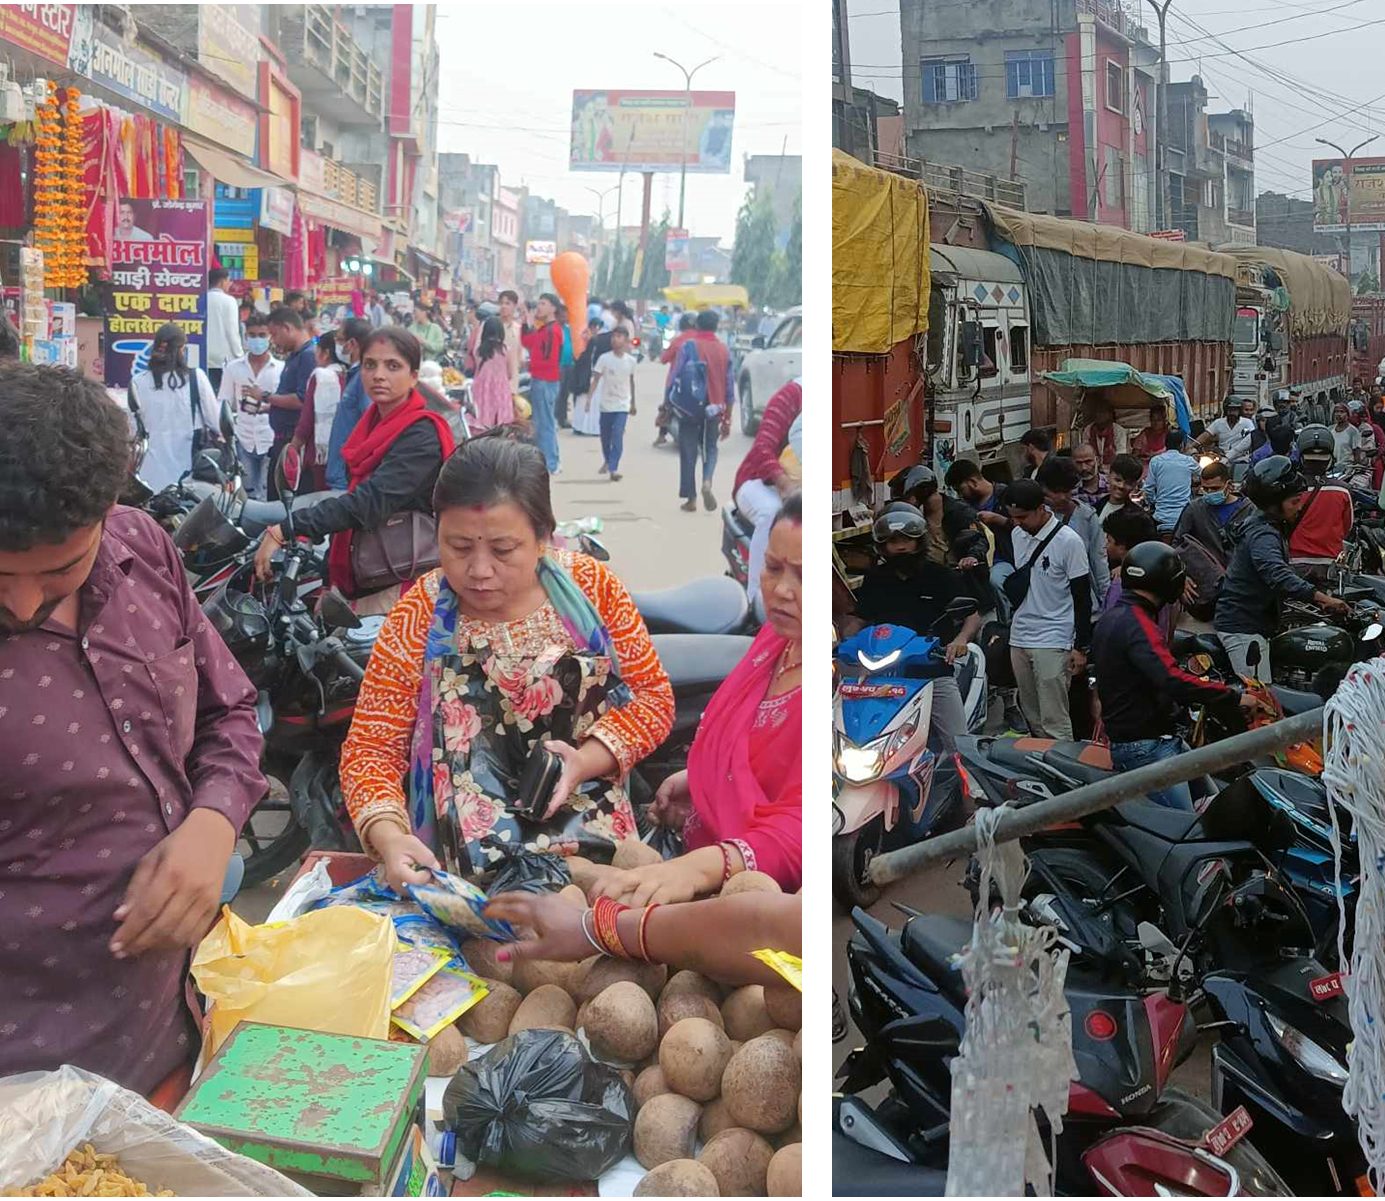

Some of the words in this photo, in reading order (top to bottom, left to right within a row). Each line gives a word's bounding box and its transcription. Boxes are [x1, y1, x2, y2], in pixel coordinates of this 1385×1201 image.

[112, 233, 204, 266] अनमोल
[113, 267, 150, 290] साड़ी
[153, 268, 203, 288] सेन्टर
[112, 292, 152, 312] एक
[156, 293, 200, 313] दाम
[1120, 1084, 1153, 1105] HONDA
